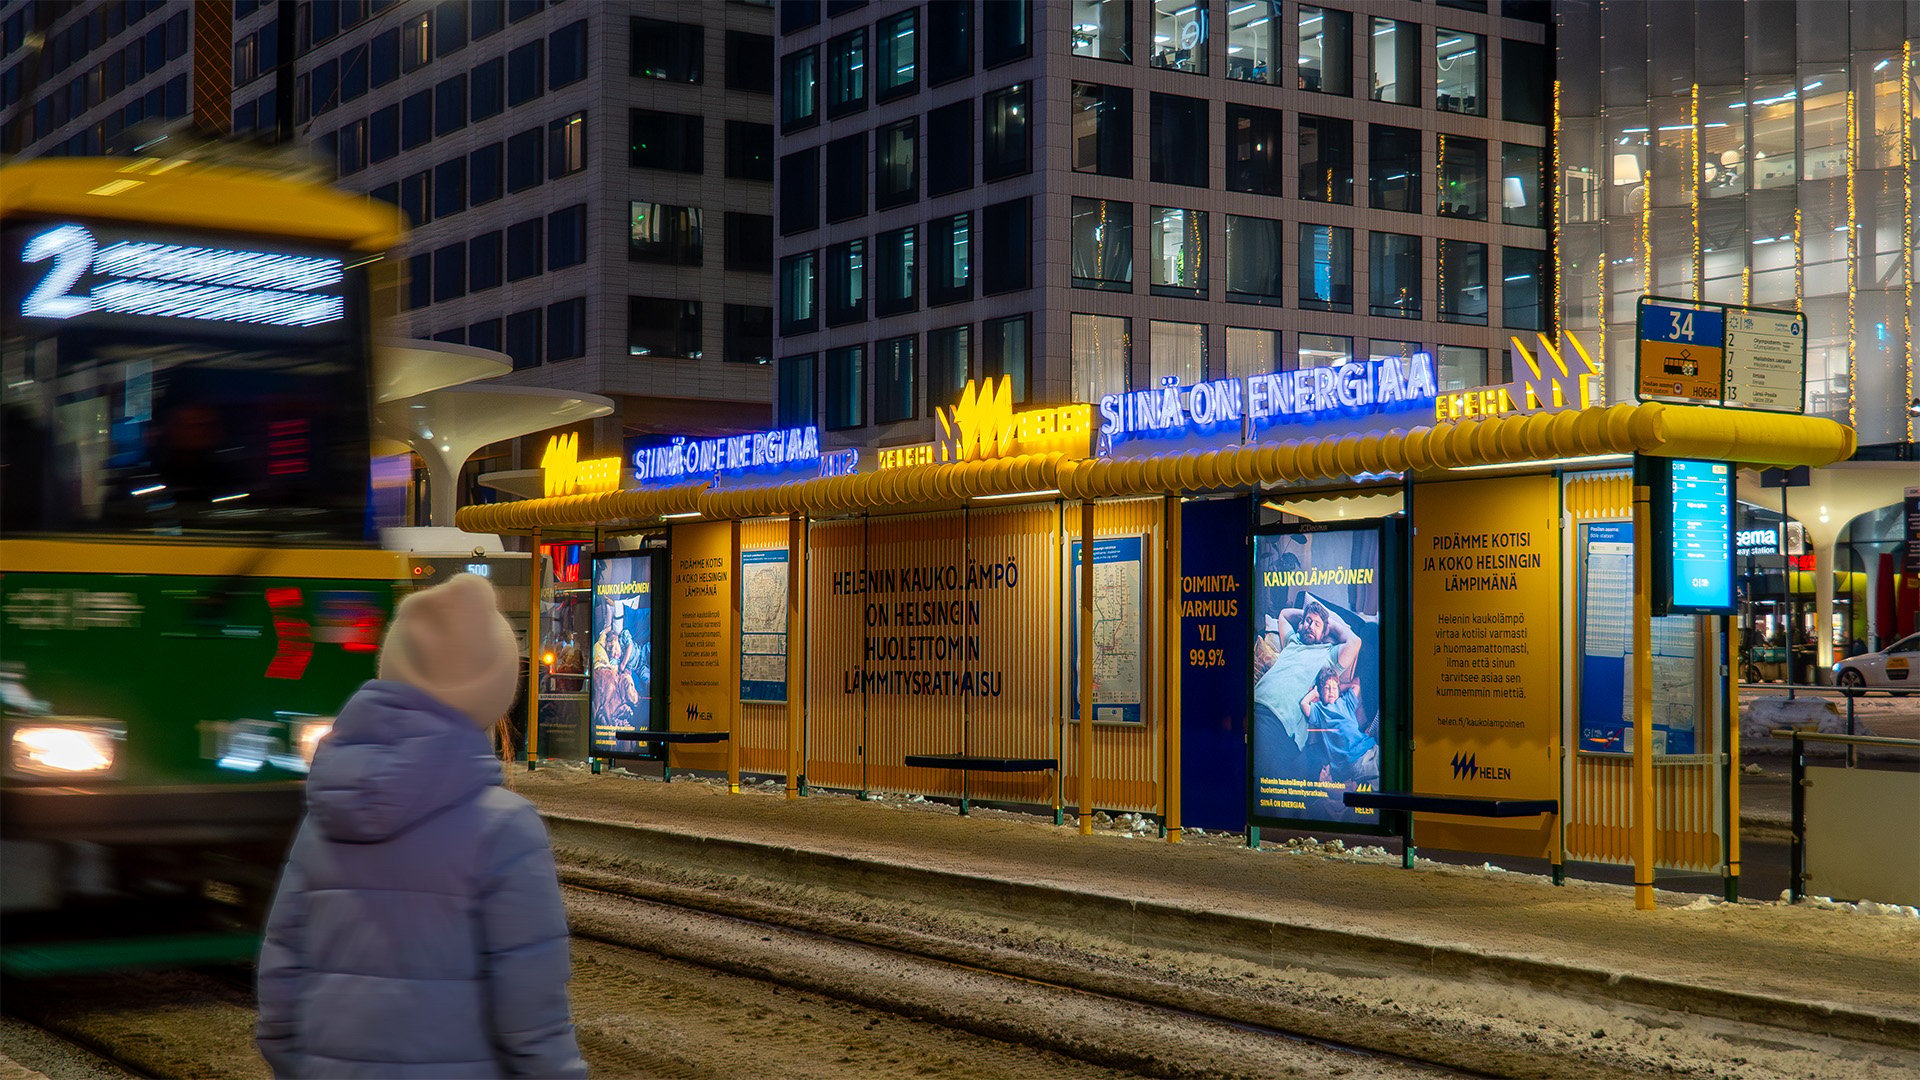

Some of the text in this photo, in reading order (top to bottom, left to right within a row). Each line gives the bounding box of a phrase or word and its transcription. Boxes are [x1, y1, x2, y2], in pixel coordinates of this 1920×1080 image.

[22, 225, 97, 318] 2
[1669, 311, 1694, 341] 34
[1728, 333, 1735, 347] 2
[1728, 351, 1734, 365] 7
[1727, 369, 1733, 382] 9
[1100, 352, 1437, 434] SIINÄ ON ENERGIAA
[1727, 386, 1737, 400] 13
[634, 436, 684, 480] SIINÄ
[686, 439, 715, 473] ON
[716, 425, 819, 470] ENERGIAA
[1720, 504, 1727, 516] 3
[1433, 532, 1531, 550] PIDÄMME KOTISI
[1751, 547, 1775, 555] station
[468, 564, 488, 576] 500
[1423, 553, 1541, 571] JA KOKO HELSINGIN
[834, 569, 895, 595] HELENIN
[1181, 575, 1240, 594] OIMINTA-
[1263, 566, 1374, 587] KAUKOLÄMPÖINEN
[1445, 573, 1518, 592] LÄMPIMÄNÄ
[866, 600, 980, 627] ON HELSINGIN
[1438, 612, 1525, 626] Helenin kaukolämpö
[1198, 624, 1216, 642] YLI
[1435, 628, 1459, 639] virtaa
[1489, 627, 1528, 639] varmasti
[866, 635, 980, 661] HUOLETTOMIN
[1433, 642, 1529, 655] ja huomaamattomasti,
[1189, 649, 1226, 668] 99,9%
[1446, 657, 1515, 668] ilman että sinun
[845, 664, 1002, 697] LÄMMITYSRATKAISU
[1441, 672, 1521, 683] tarvitsee asiaa sen
[1436, 686, 1526, 699] kummemmin miettiä.
[1480, 768, 1511, 780] HELEN
